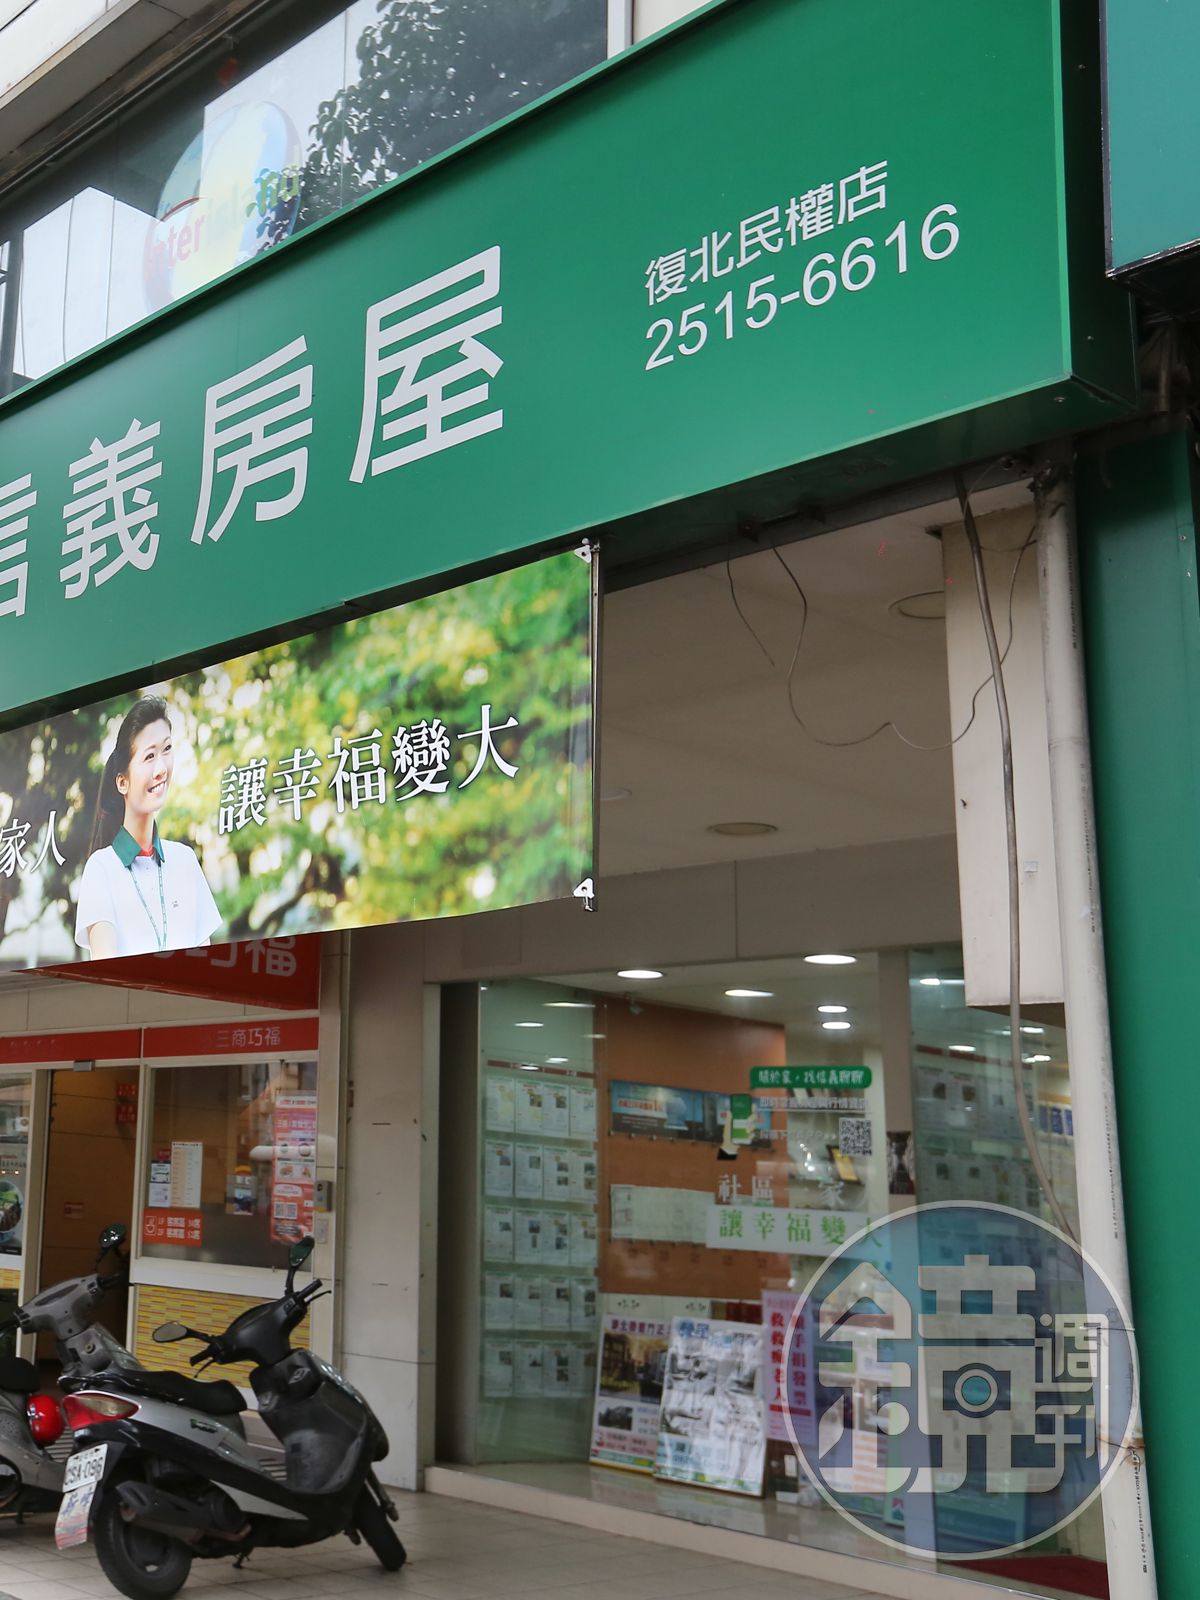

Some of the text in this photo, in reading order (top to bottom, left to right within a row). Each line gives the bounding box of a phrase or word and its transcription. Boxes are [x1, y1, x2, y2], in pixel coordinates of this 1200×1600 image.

[644, 159, 888, 307] 復北民權店
[644, 202, 961, 371] 2515-6616
[218, 704, 520, 835] 讓幸福變大
[216, 1026, 281, 1048] 三商巧福
[718, 1207, 884, 1249] 讓幸福變大
